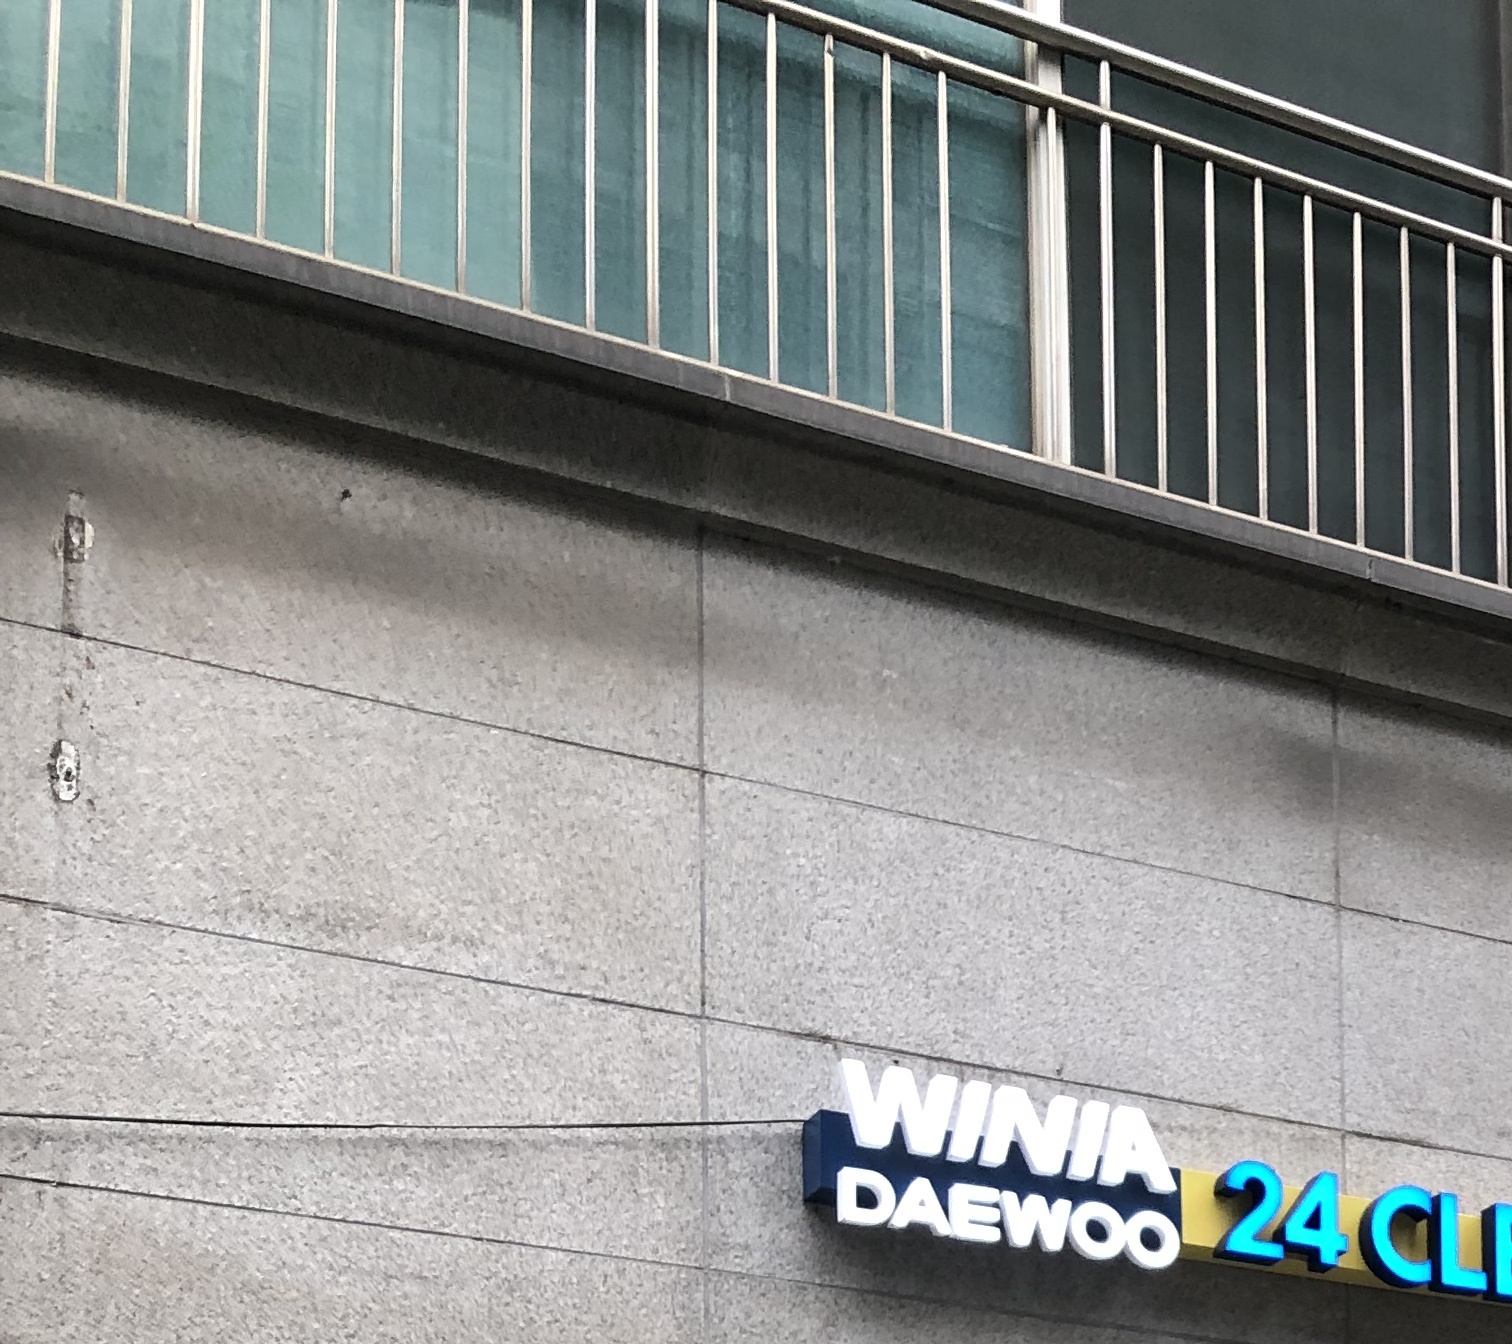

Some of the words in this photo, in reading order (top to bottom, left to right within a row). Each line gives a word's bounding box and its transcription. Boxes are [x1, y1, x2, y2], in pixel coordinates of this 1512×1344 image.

[840, 1058, 1177, 1193] WINIA
[836, 1166, 1180, 1270] DAEWOO
[1214, 1160, 1350, 1271] 24
